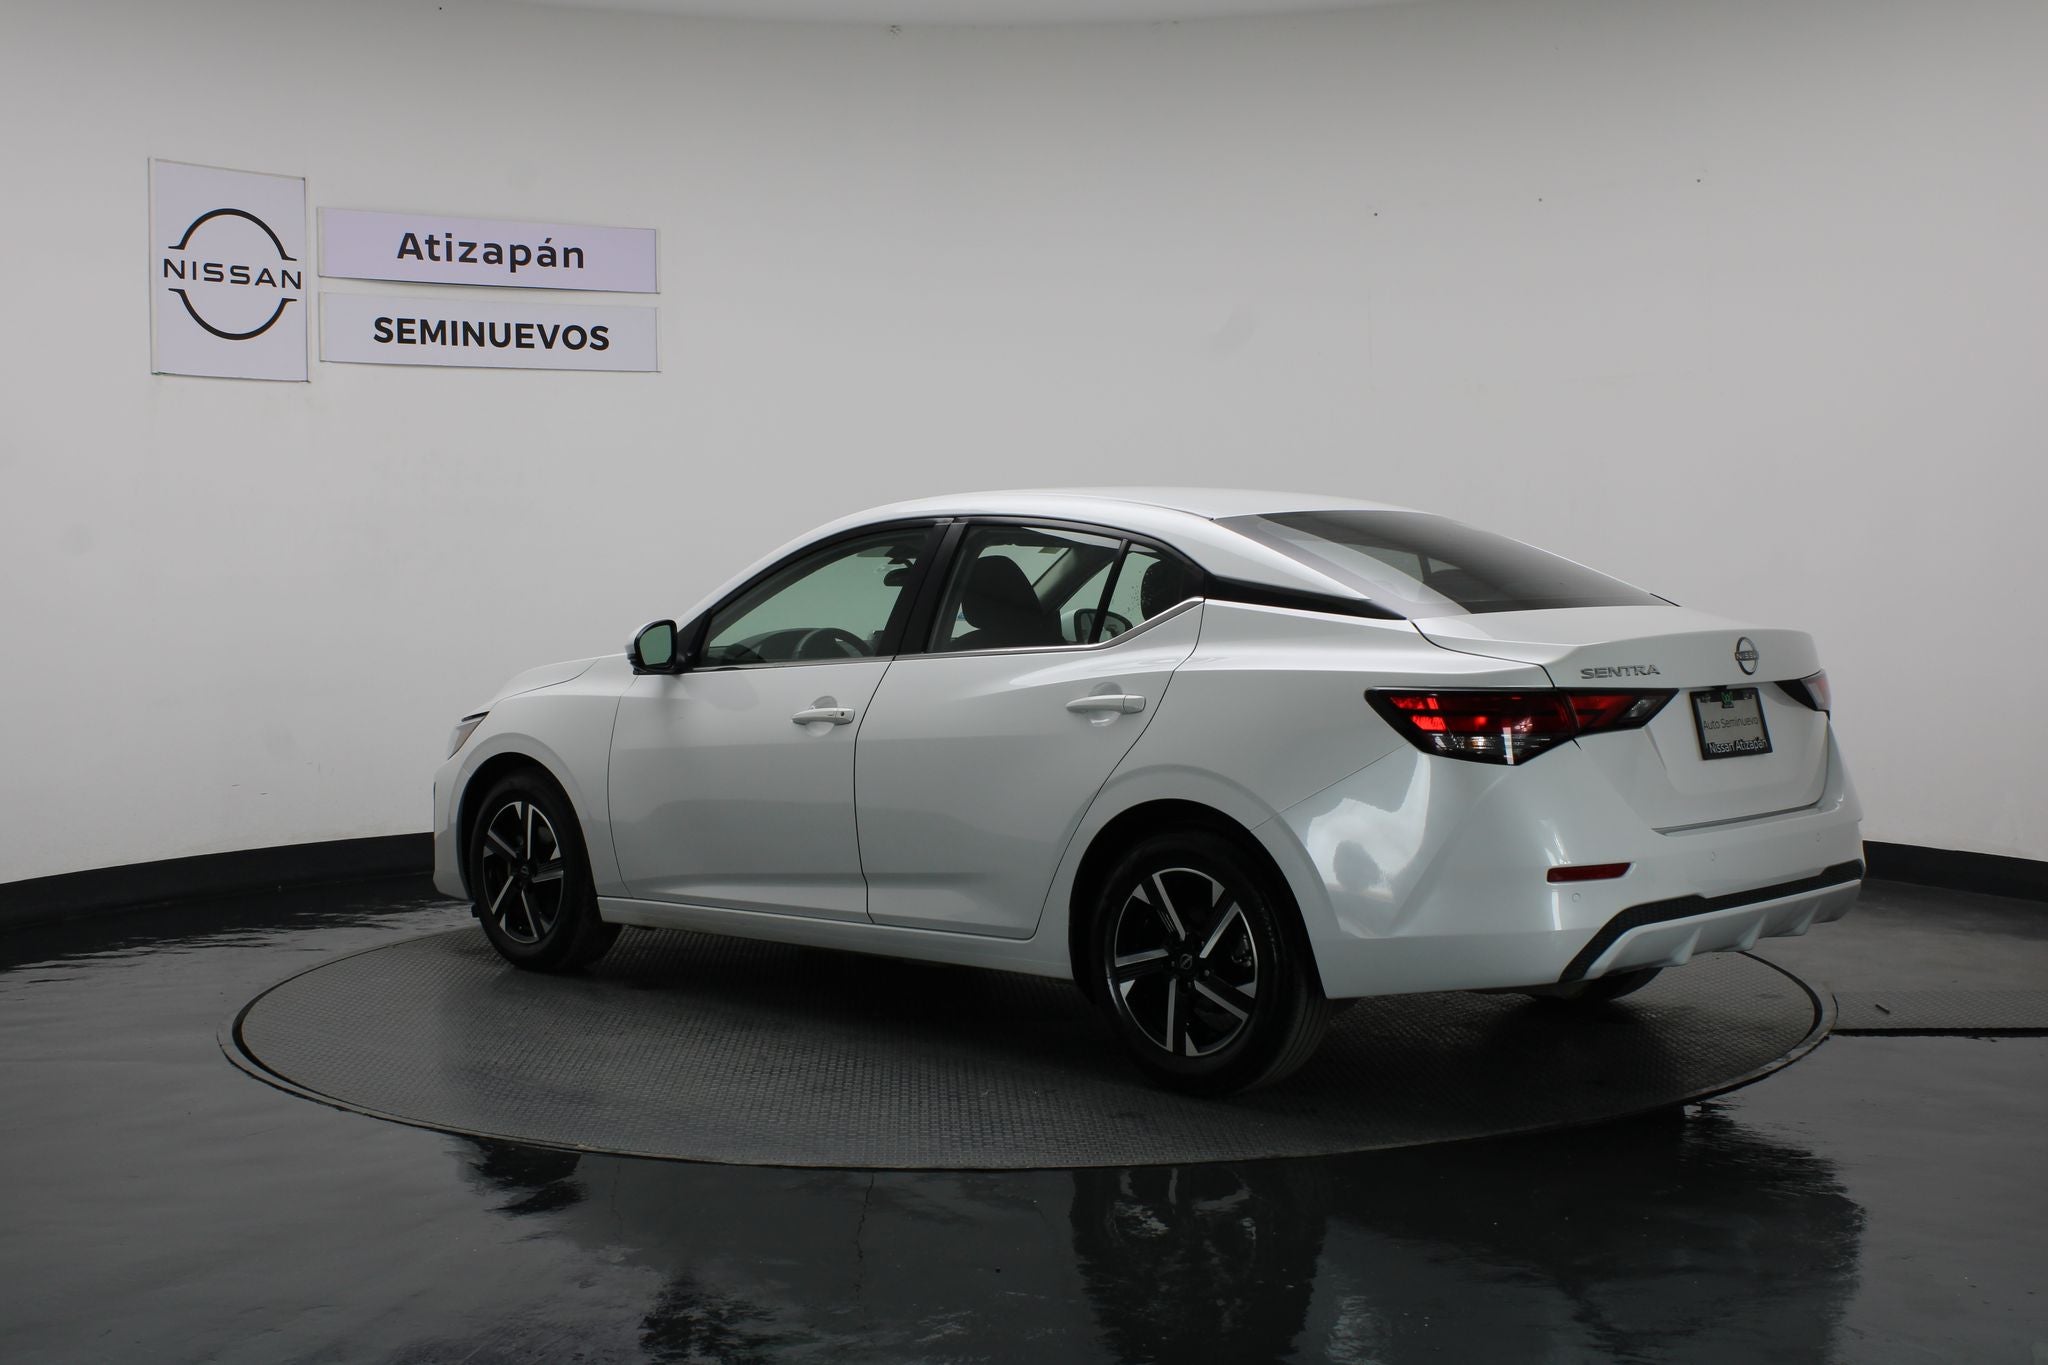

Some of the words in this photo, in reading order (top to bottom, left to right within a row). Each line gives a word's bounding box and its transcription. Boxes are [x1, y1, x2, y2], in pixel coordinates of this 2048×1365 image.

[396, 231, 585, 273] Atizapán
[163, 258, 302, 290] NISSAN
[373, 316, 610, 351] SEMINUEVOS
[1580, 664, 1661, 680] SENTRA
[1703, 719, 1721, 730] Auto
[1709, 742, 1734, 754] Nissan
